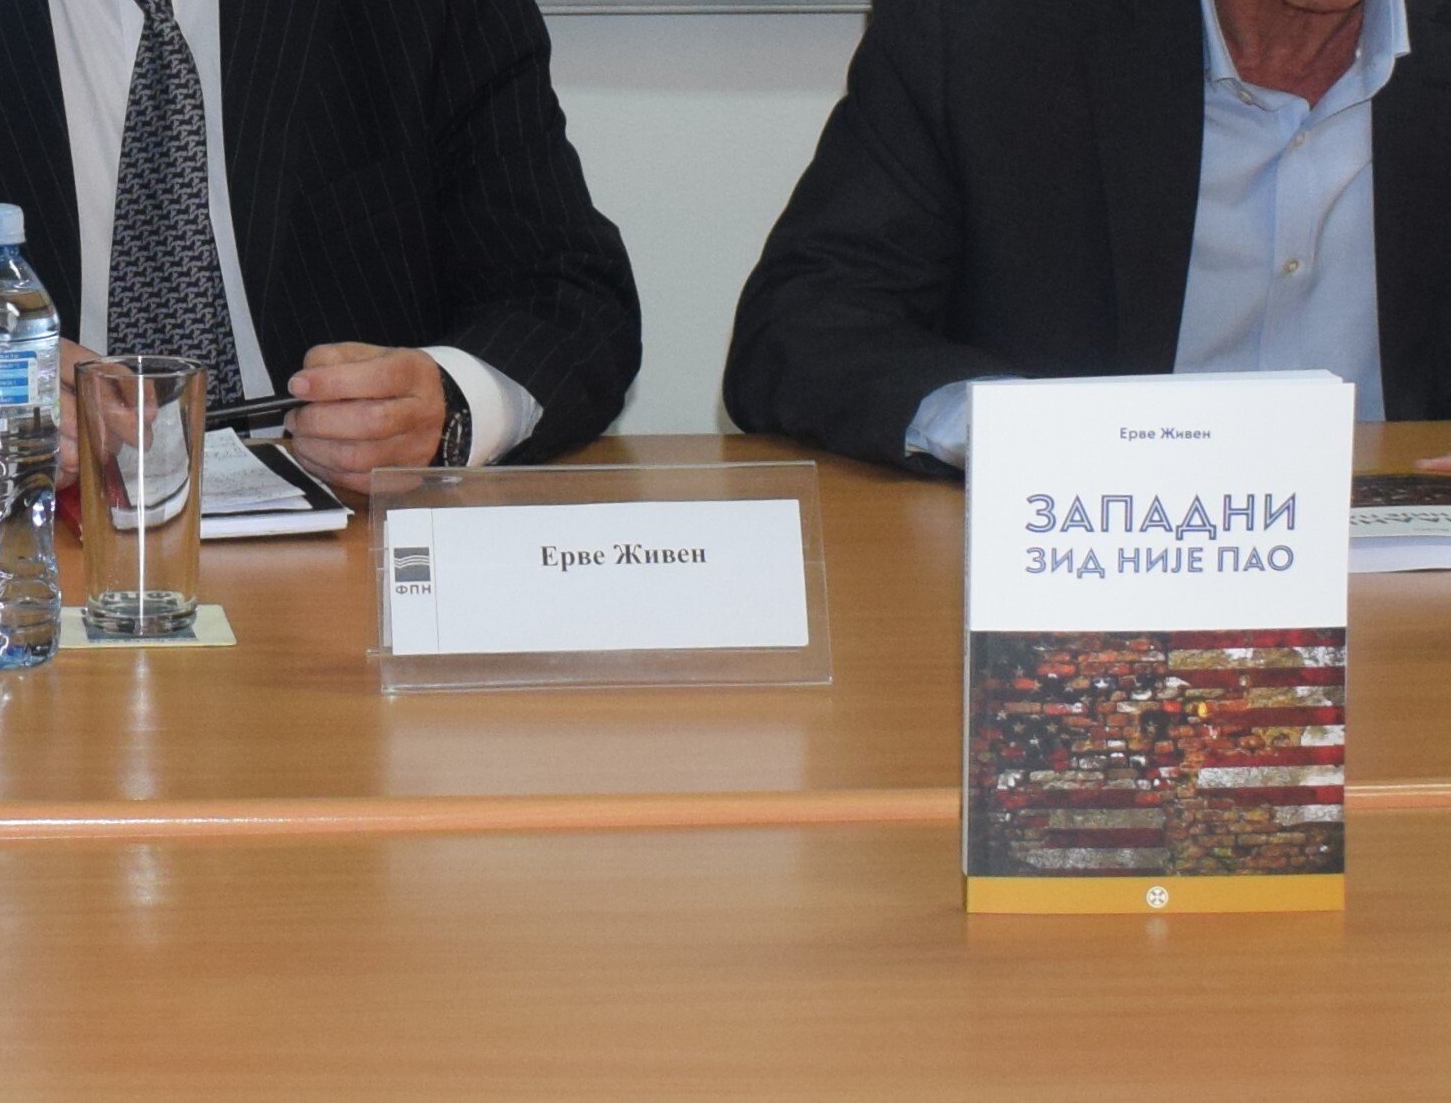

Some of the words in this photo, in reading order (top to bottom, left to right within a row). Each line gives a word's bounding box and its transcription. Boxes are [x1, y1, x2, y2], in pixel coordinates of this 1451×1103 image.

[1119, 427, 1156, 443] Ерве
[1160, 427, 1211, 440] Живен
[1025, 492, 1297, 541] ЗАПАДНИ
[541, 545, 606, 572] Ерве
[613, 543, 708, 565] Живен
[1025, 546, 1106, 579] ЗИД
[1117, 546, 1204, 575] НИЈЕ
[1217, 544, 1295, 573] ПАО
[395, 584, 432, 595] ФПН
